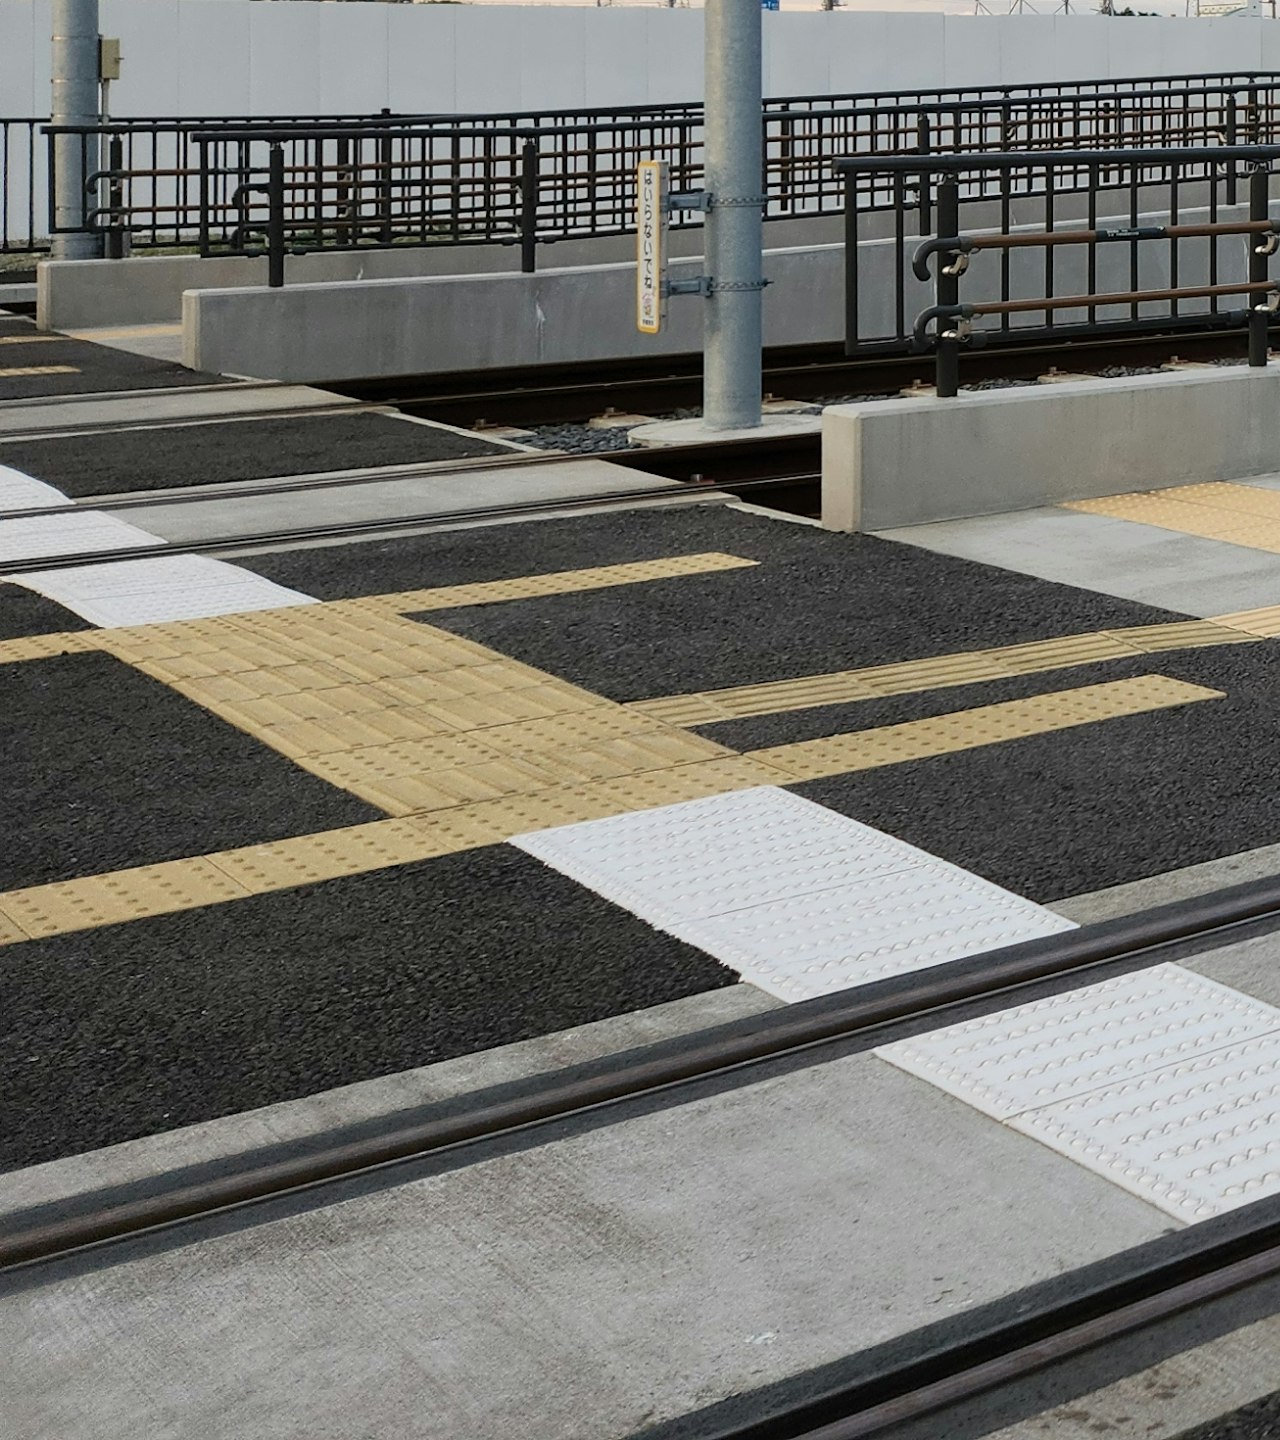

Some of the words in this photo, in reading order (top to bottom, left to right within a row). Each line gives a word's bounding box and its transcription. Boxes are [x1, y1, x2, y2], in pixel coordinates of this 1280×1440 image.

[643, 169, 653, 288] はいらないでね
